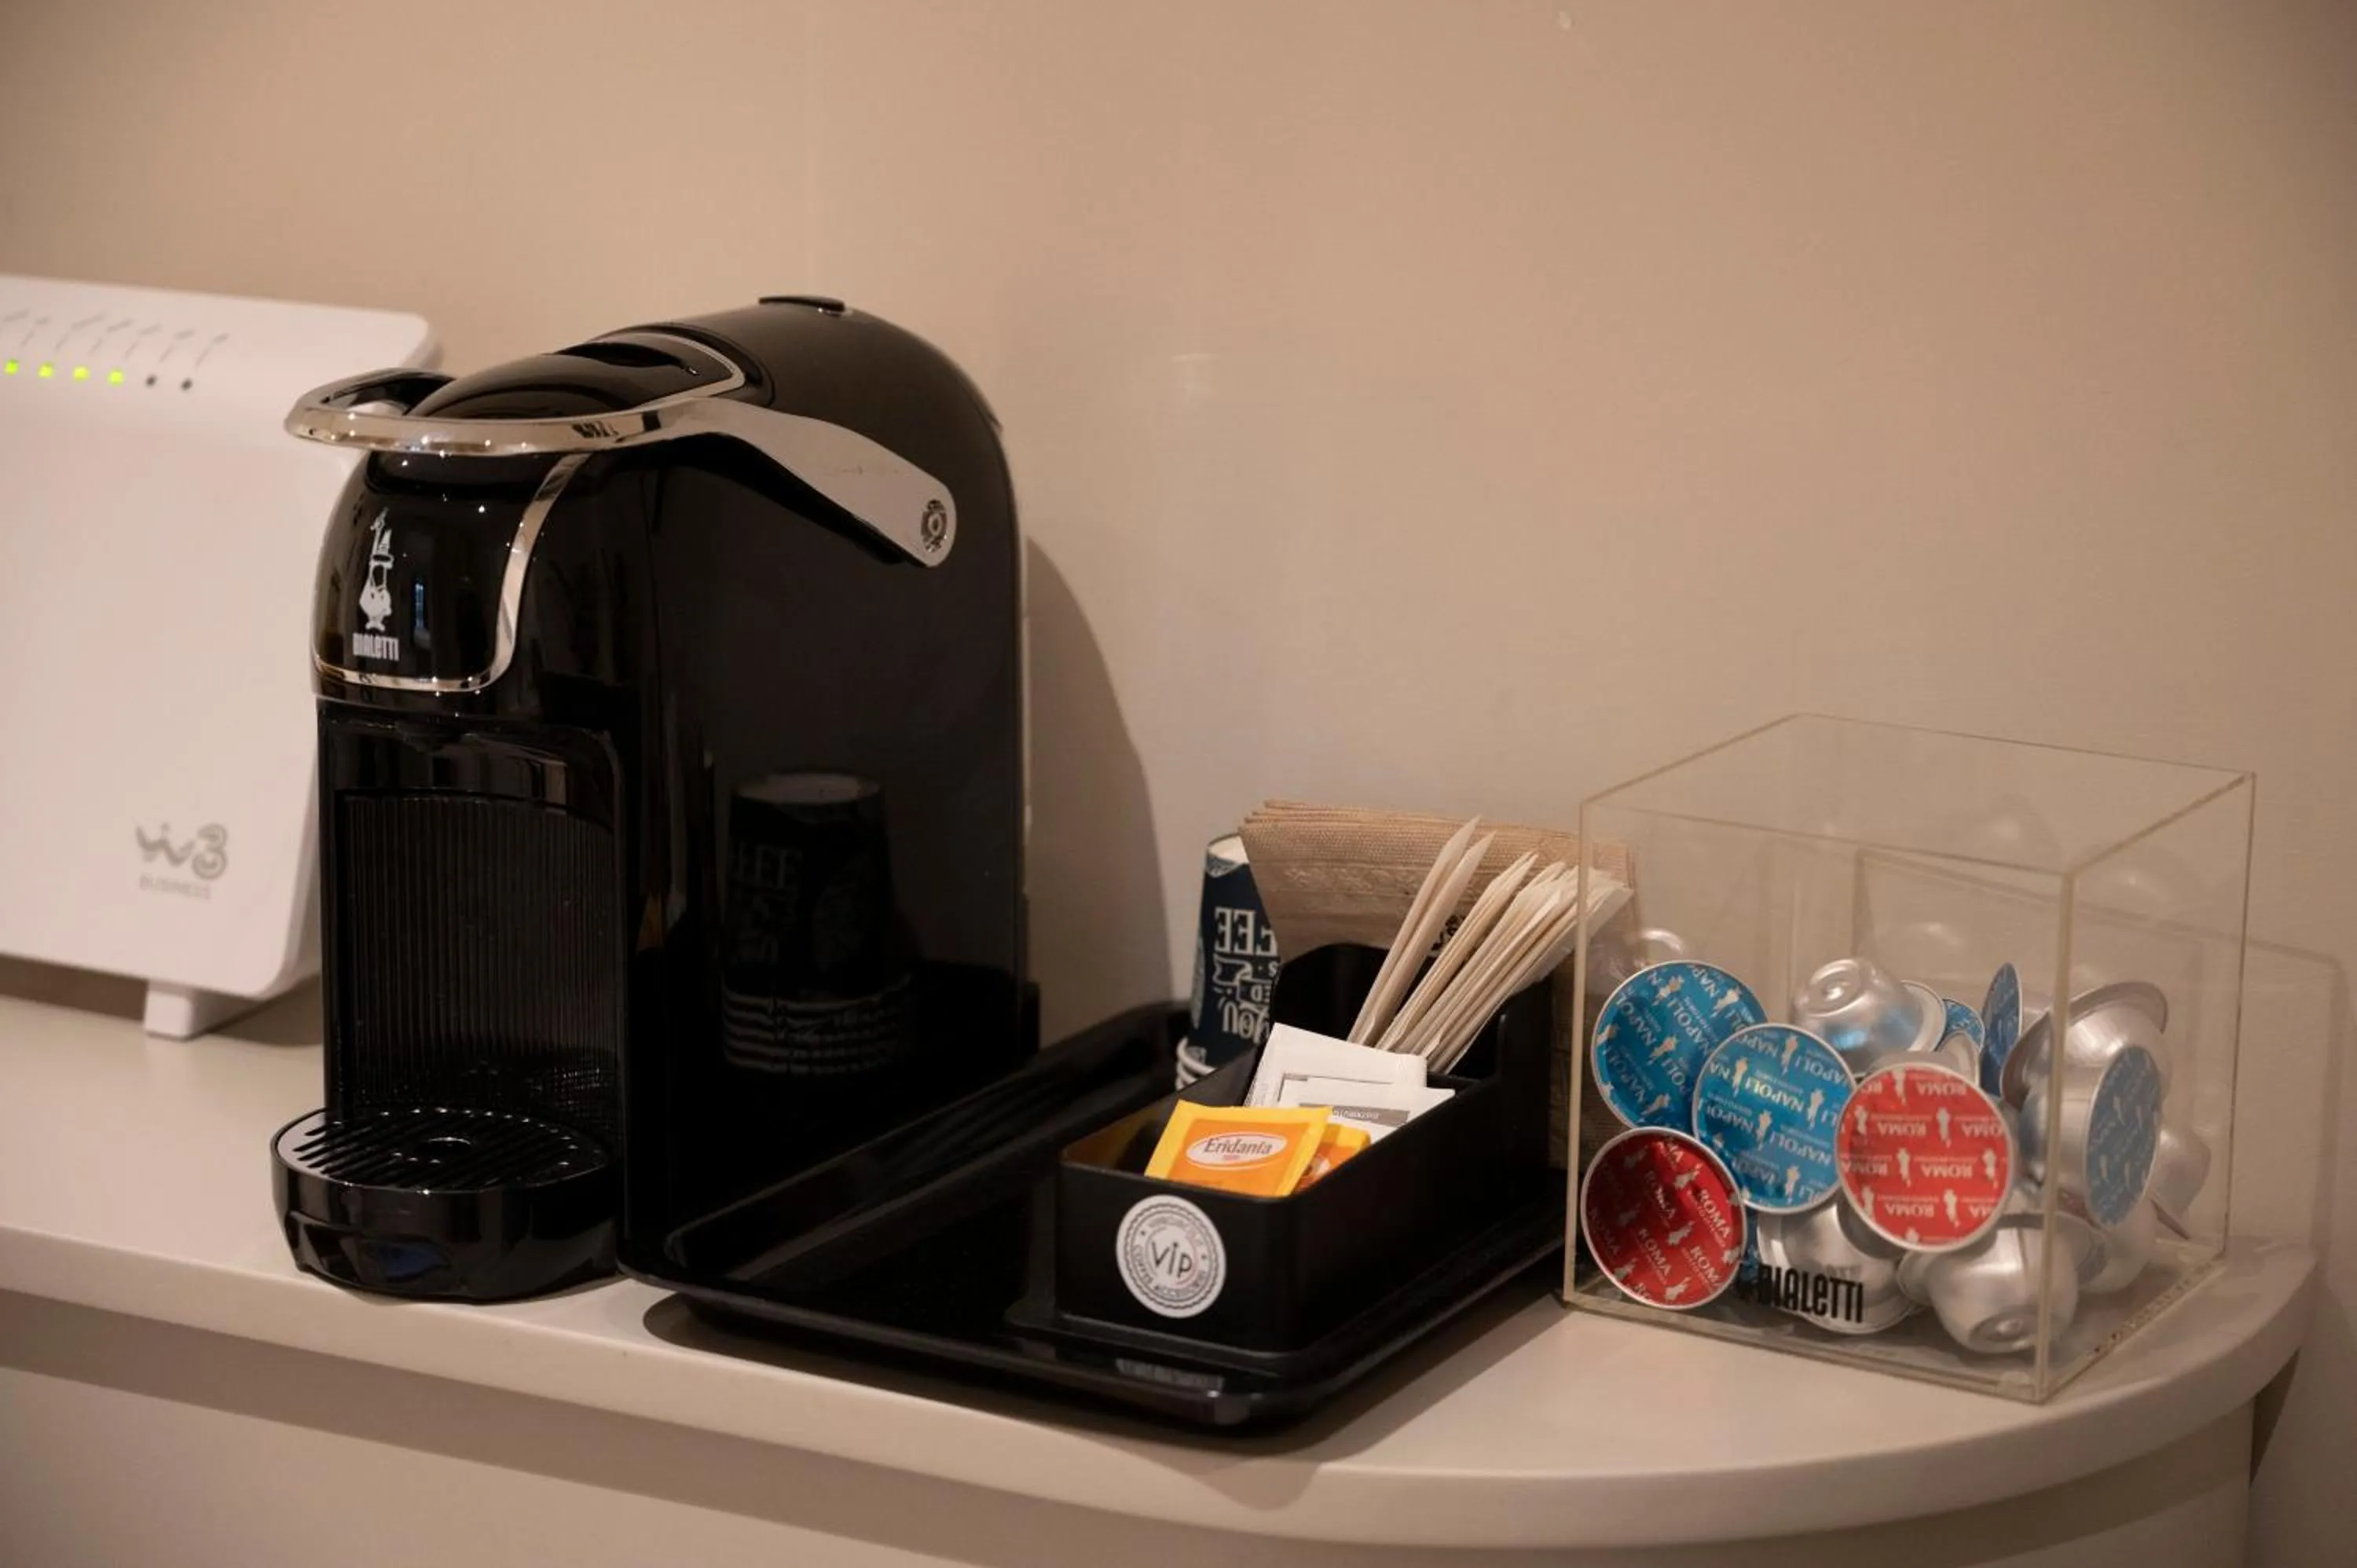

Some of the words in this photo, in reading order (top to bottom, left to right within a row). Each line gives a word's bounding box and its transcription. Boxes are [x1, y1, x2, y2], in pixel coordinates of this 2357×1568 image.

[1744, 1076, 1805, 1113] NAPOLI
[1876, 1120, 1926, 1138] ROMA
[1961, 1123, 2004, 1138] OMA
[1203, 1138, 1274, 1156] Eridania
[1769, 1130, 1832, 1167] NAPOLI
[1920, 1163, 1974, 1179] ROMA
[1699, 1189, 1732, 1239] ROMA
[1885, 1203, 1935, 1218] ROMA
[1638, 1227, 1673, 1277] ROMA
